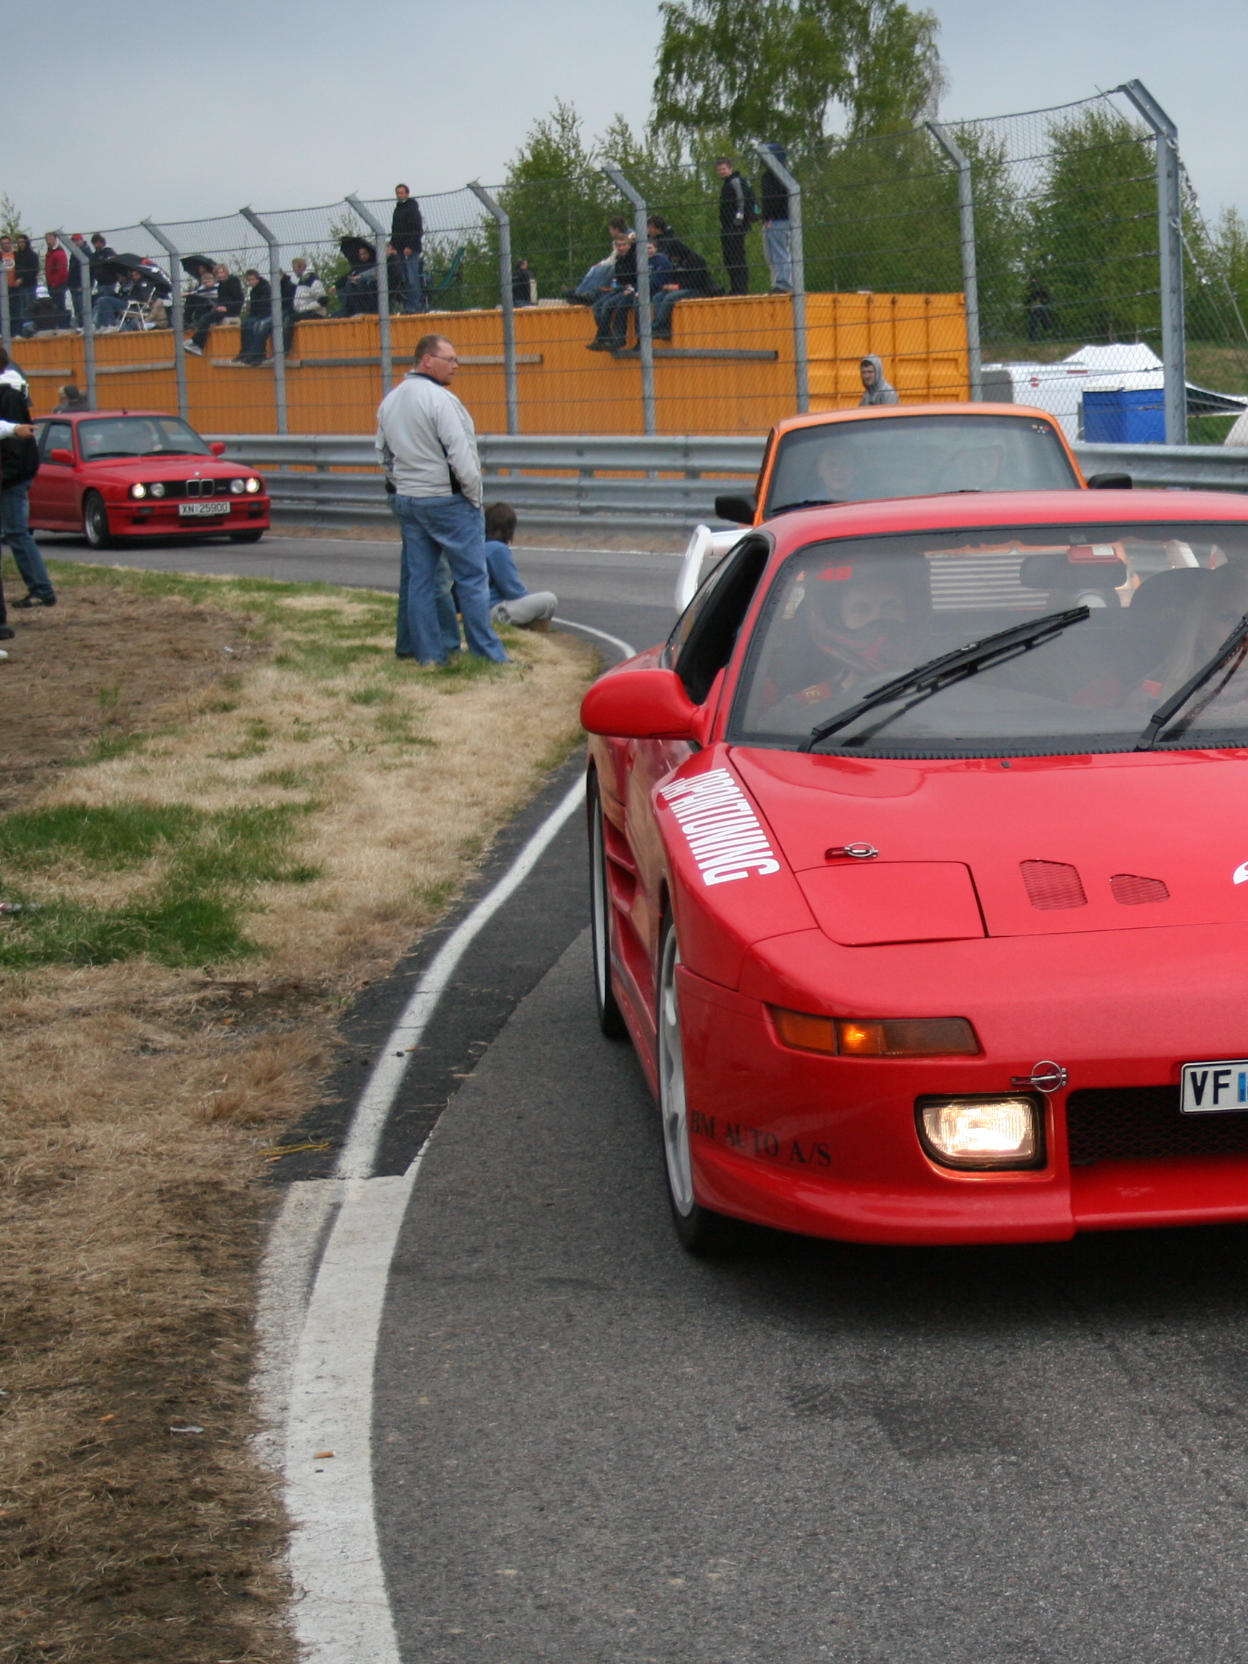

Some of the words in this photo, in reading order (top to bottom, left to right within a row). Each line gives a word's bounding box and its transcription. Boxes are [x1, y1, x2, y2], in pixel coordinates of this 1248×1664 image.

[182, 504, 195, 514] XN
[200, 502, 228, 513] 25900
[816, 566, 854, 581] 48
[1190, 1069, 1232, 1106] VF
[723, 1120, 780, 1158] AUTO
[790, 1139, 833, 1168] A/S
